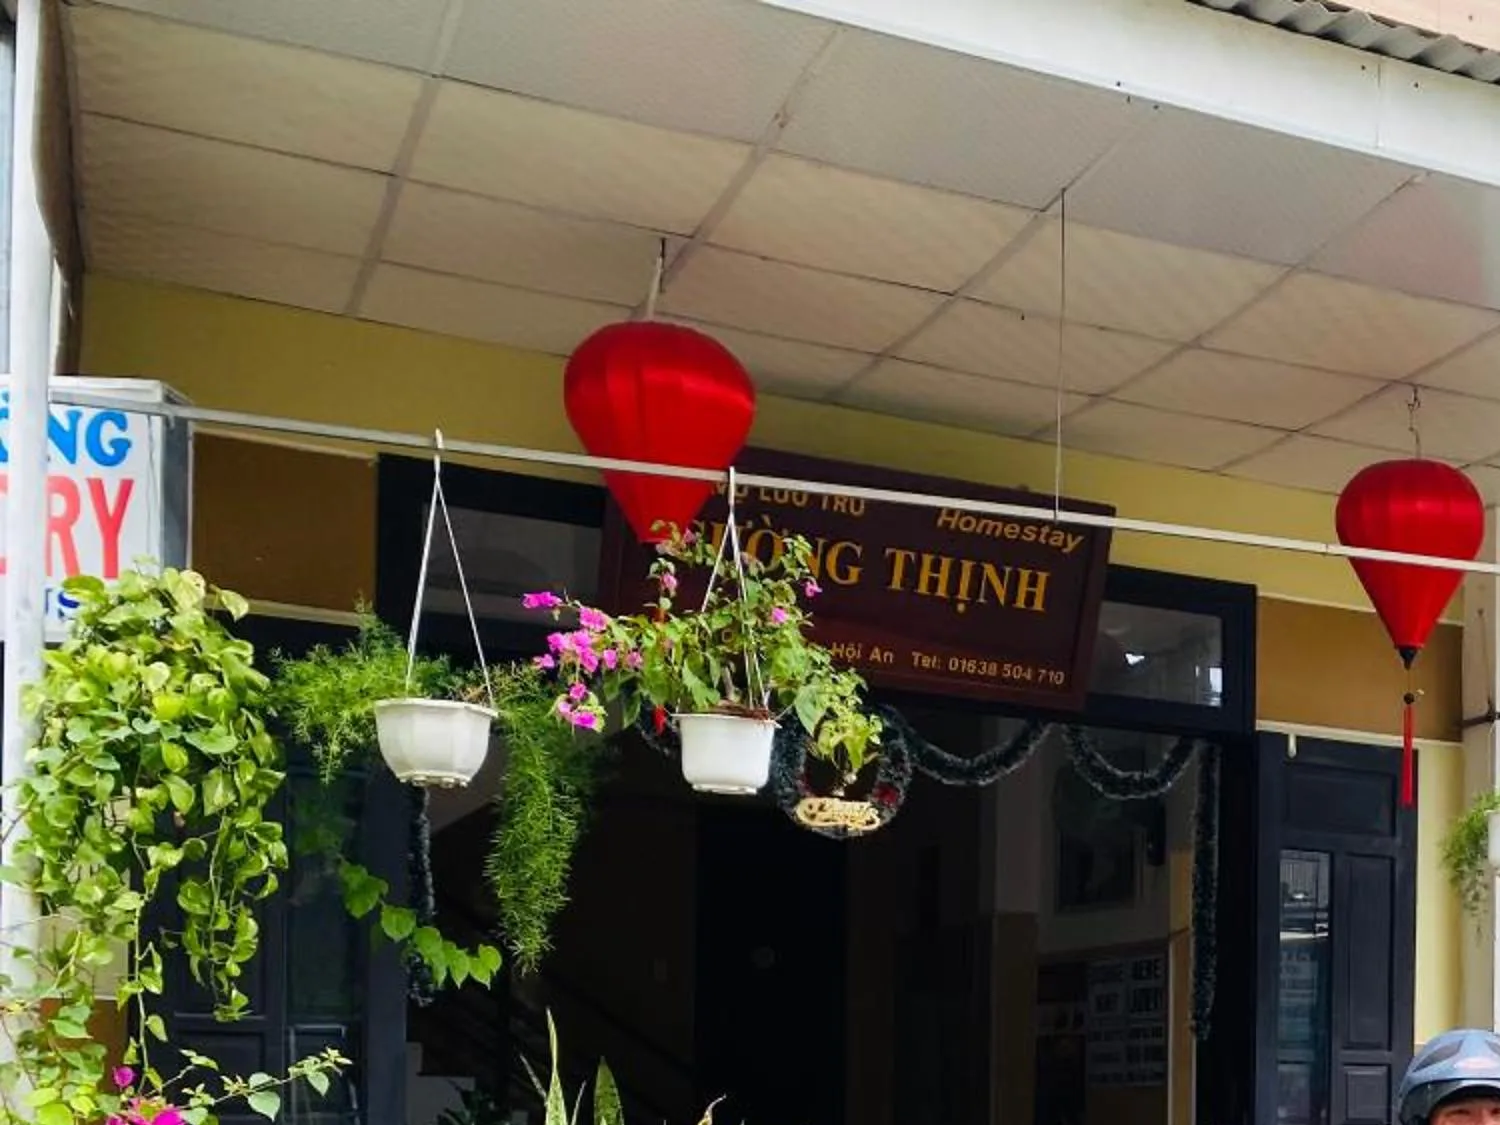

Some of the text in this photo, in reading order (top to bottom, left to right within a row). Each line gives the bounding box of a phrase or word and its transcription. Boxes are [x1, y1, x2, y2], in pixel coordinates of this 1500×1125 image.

[937, 507, 1085, 553] Homestay
[884, 546, 1051, 613] THỊNH
[869, 648, 894, 664] An
[911, 651, 941, 671] Tel:
[1037, 668, 1065, 686] 710
